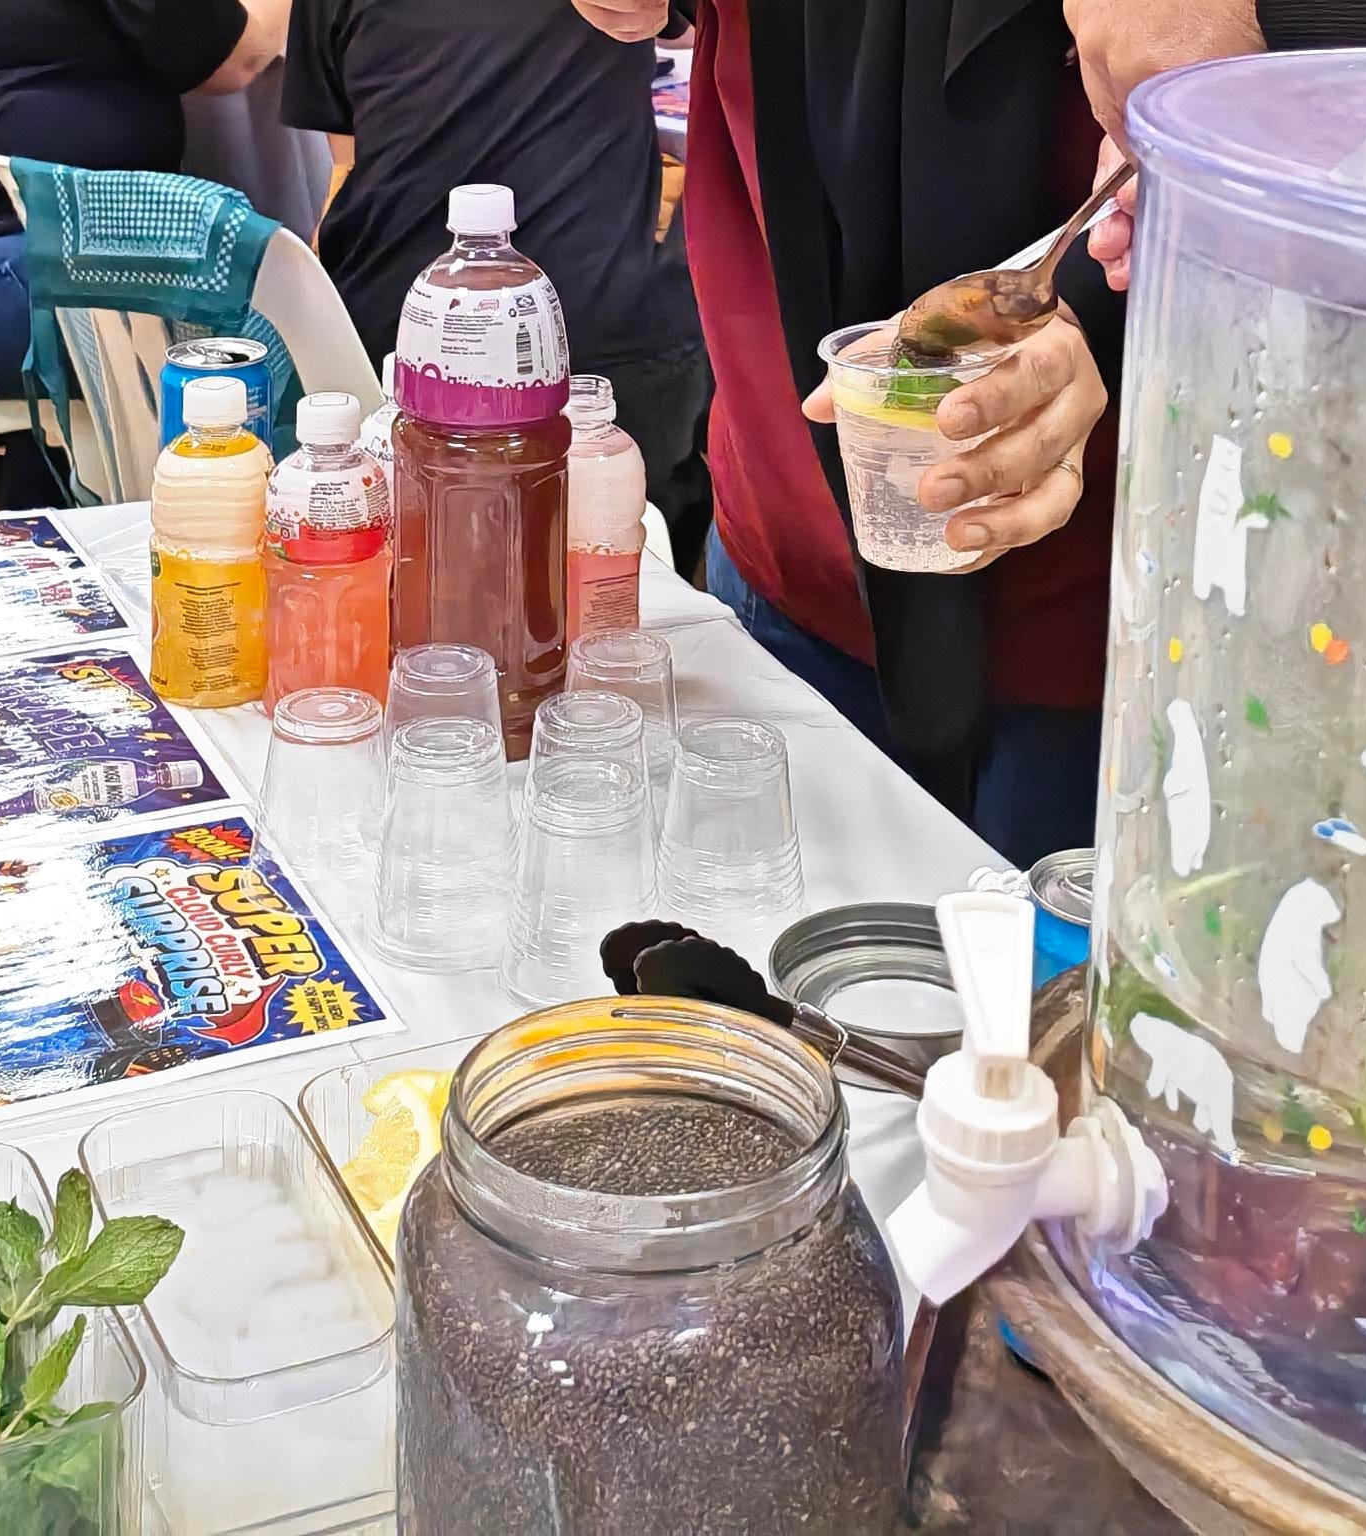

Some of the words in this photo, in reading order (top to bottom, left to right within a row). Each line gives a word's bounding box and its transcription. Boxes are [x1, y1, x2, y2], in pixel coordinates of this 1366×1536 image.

[174, 827, 250, 860] BOOM!
[164, 884, 226, 932] CLOUD
[201, 931, 256, 979] CURLY
[189, 865, 327, 978] SUPER
[111, 875, 237, 1017] SURPRISE
[303, 997, 328, 1014] HAPPY
[316, 989, 336, 1000] BE
[324, 1003, 350, 1021] HERO
